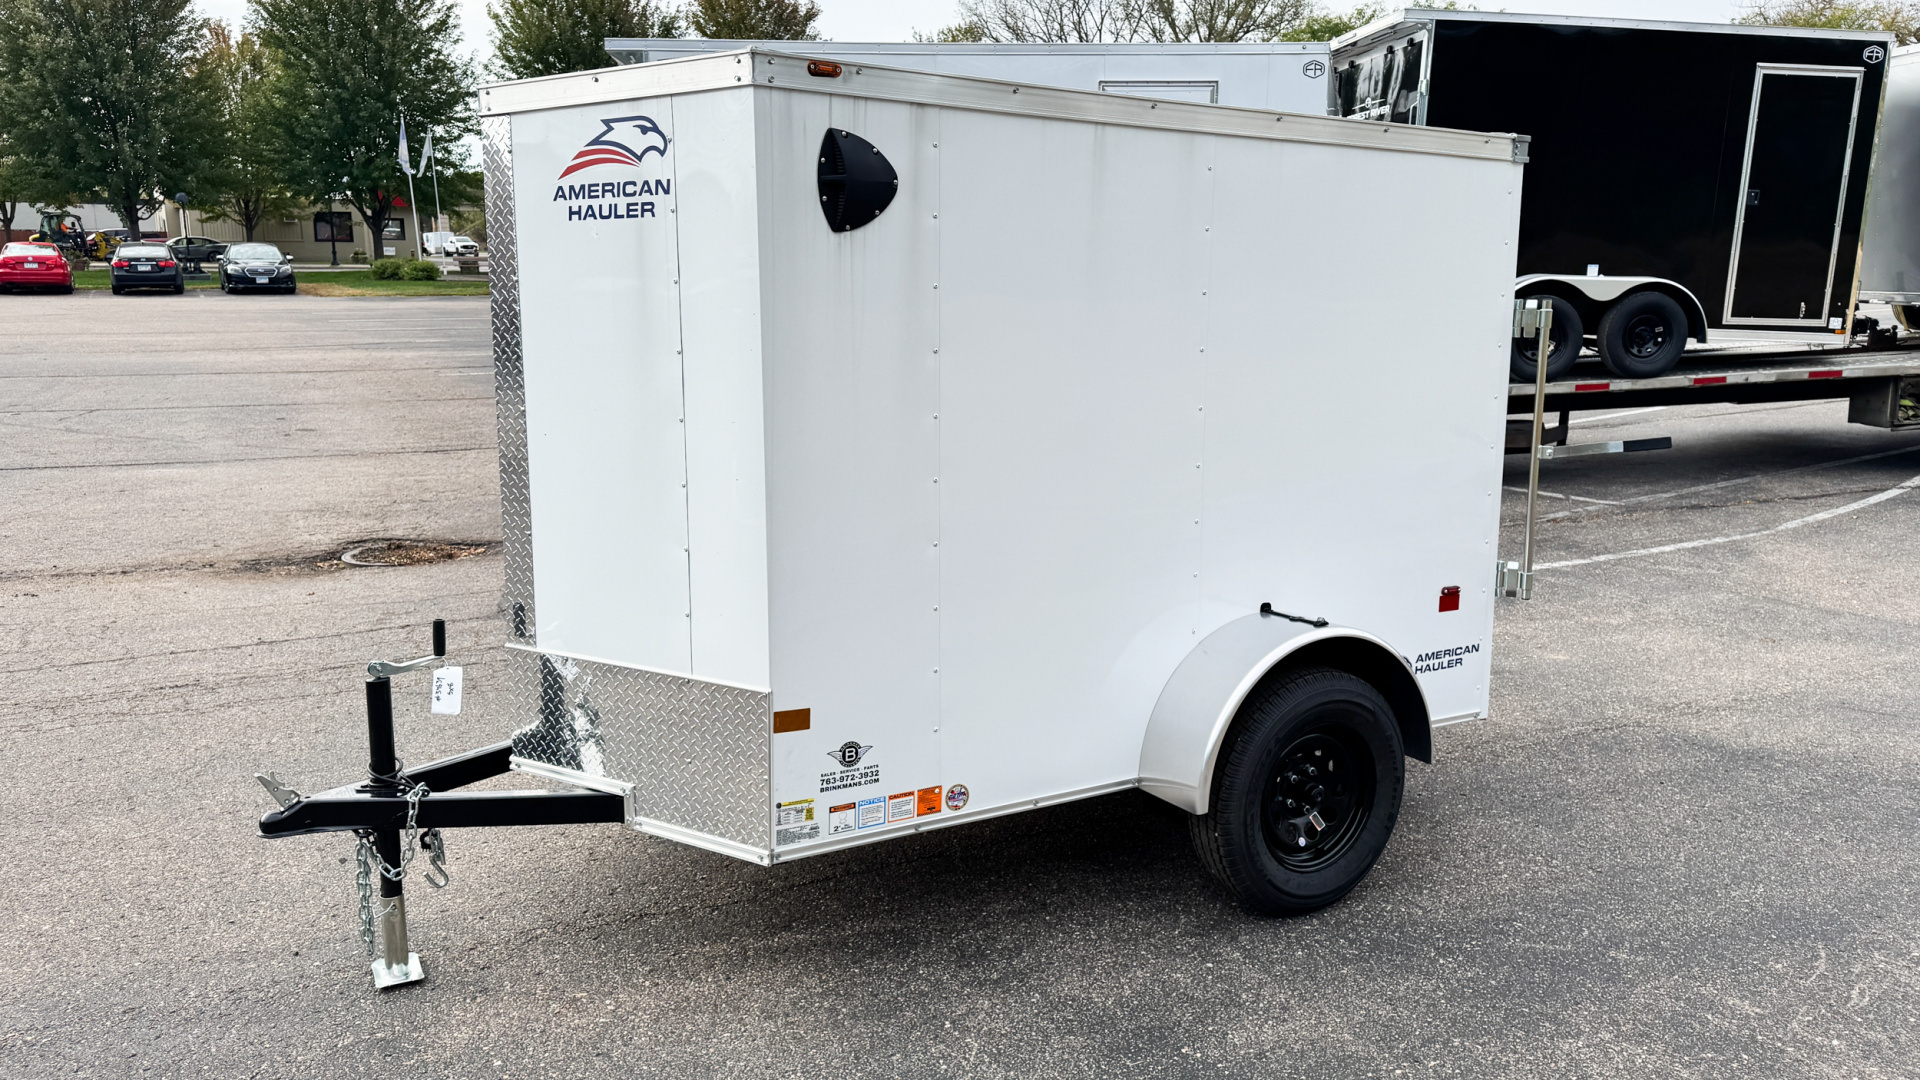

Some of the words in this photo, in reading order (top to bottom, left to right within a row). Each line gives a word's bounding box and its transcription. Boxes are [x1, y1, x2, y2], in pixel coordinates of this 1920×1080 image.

[1370, 104, 1390, 117] RIVER
[553, 179, 671, 202] AMERICAN
[568, 202, 656, 221] HAULER
[1415, 643, 1480, 664] AMERICAN
[1415, 658, 1463, 675] HAULER
[845, 747, 857, 762] B
[820, 769, 880, 786] 763-972-3932
[840, 767, 860, 775] SERVICE
[820, 777, 880, 793] BRINKMANS.COM
[859, 797, 885, 806] NOTICE
[889, 791, 914, 800] CAUTION
